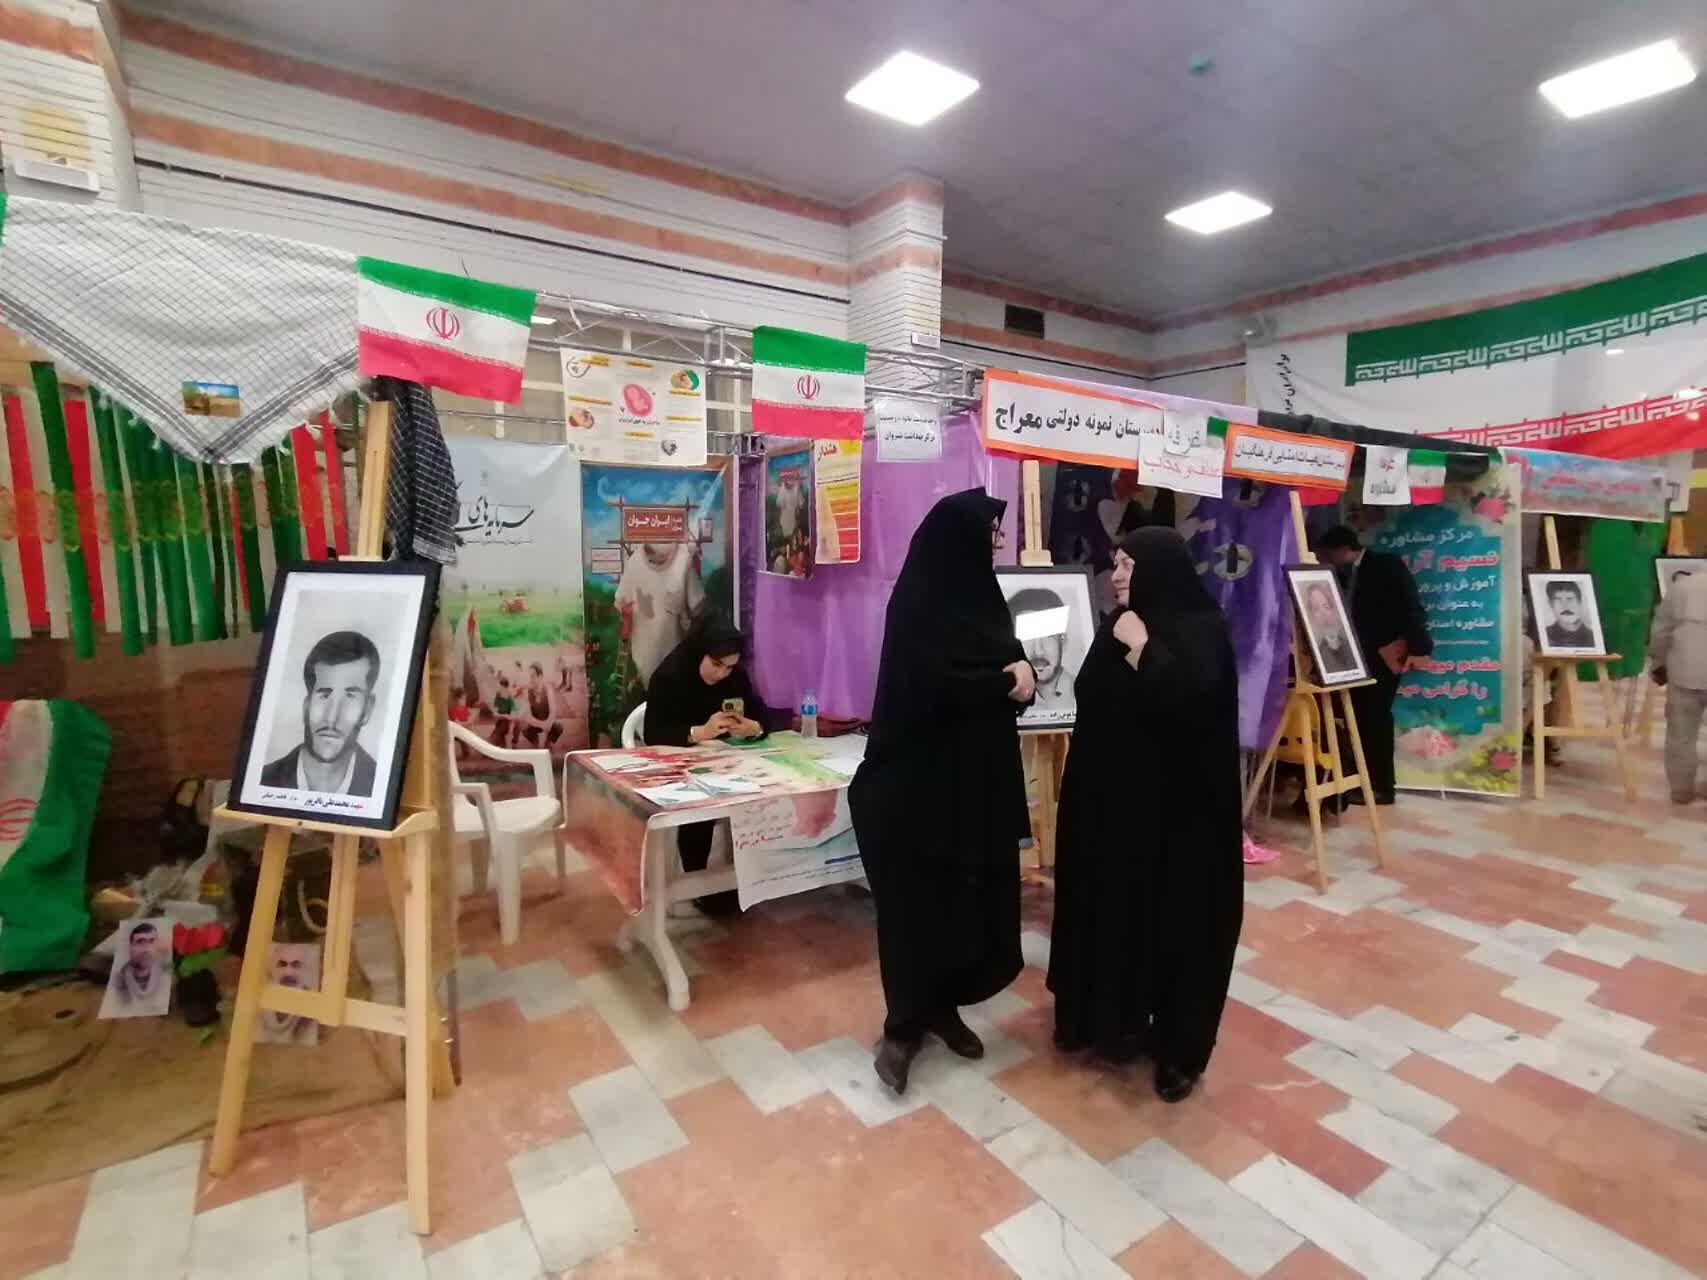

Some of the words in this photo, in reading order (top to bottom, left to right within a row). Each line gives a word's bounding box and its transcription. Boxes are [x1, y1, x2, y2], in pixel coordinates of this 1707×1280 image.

[995, 402, 1042, 434] معراج
[1046, 408, 1080, 431] دولتی
[1085, 412, 1112, 435] نمونه
[627, 513, 650, 528] جوان
[650, 514, 671, 528] ایران
[1380, 532, 1435, 548] مشاوره
[1440, 527, 1473, 545] مرکز
[1418, 583, 1442, 593] پرور
[1453, 575, 1496, 592] آموزش
[1455, 617, 1494, 630] مشاوره
